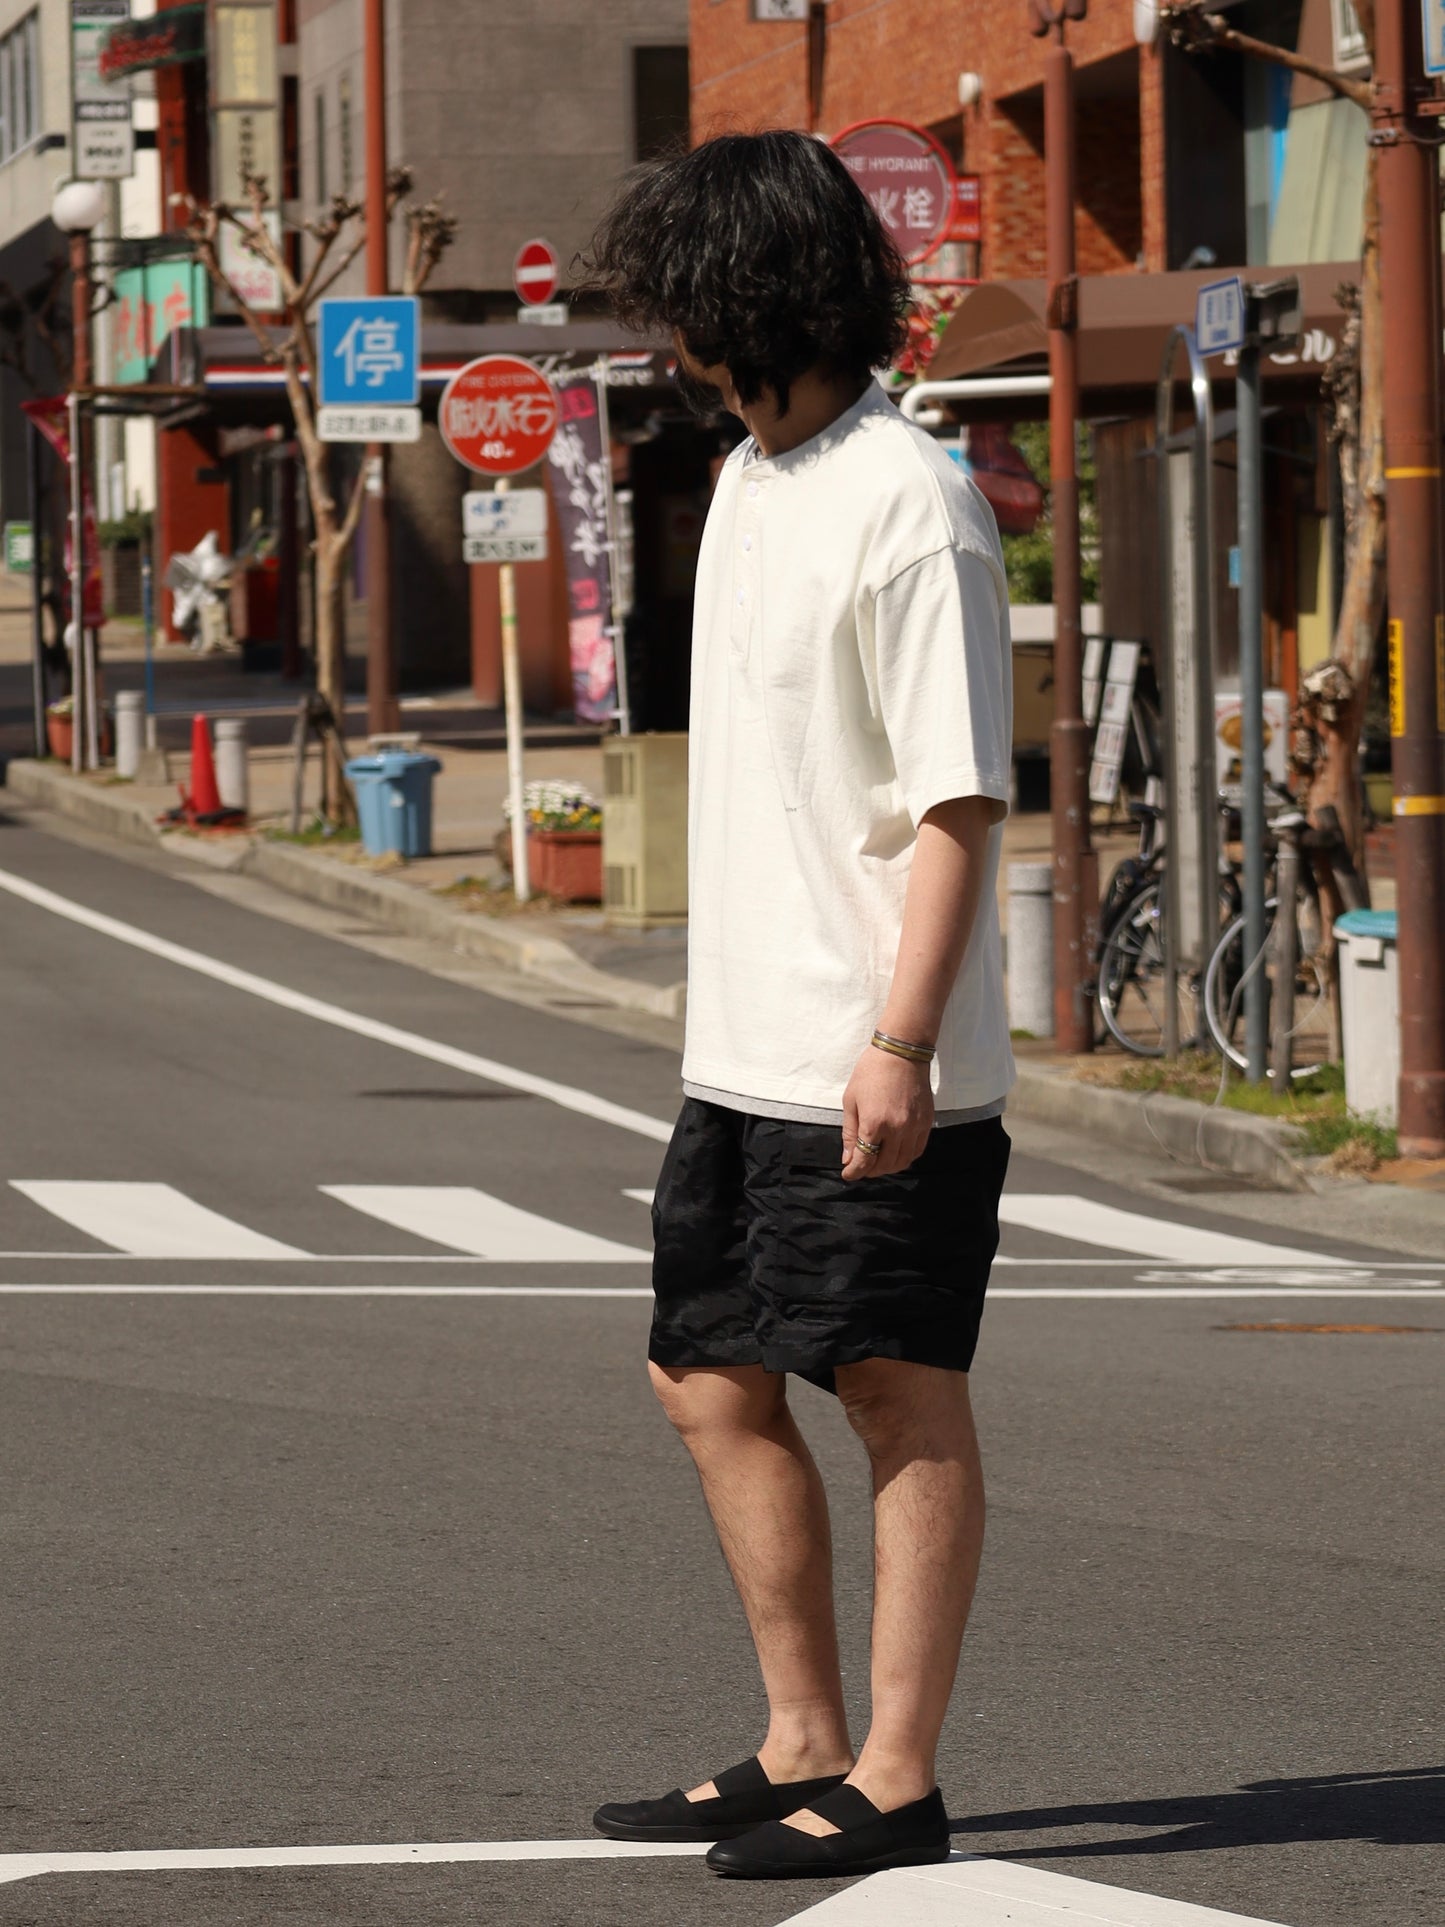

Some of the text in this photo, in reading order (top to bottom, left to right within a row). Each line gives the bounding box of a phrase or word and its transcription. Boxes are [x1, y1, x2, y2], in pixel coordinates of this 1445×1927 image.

[868, 156, 930, 171] HYDRANT
[868, 186, 935, 229] 火栓
[334, 316, 404, 387] 停
[460, 375, 485, 389] FIRE
